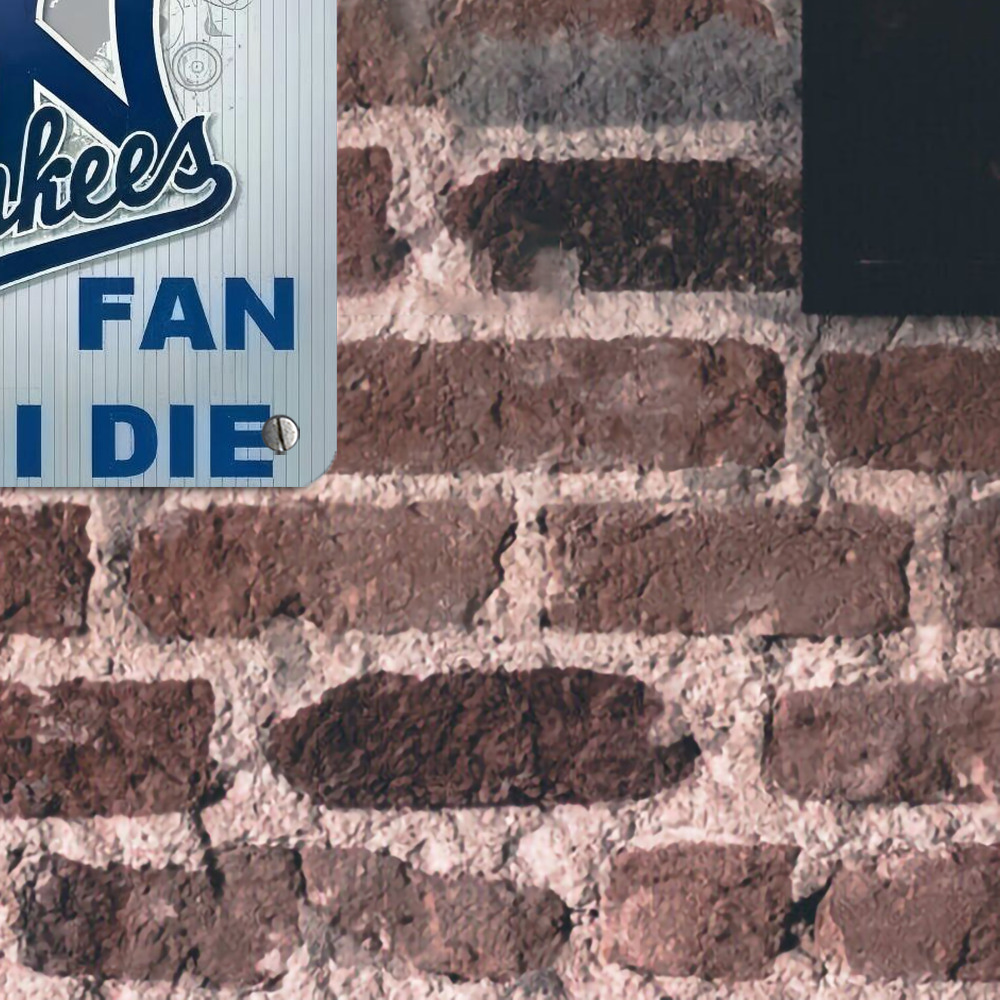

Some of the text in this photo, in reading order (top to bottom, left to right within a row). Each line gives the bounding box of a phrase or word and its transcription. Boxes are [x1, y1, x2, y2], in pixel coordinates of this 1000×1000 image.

[78, 276, 296, 351] FAN
[16, 404, 42, 479] I
[91, 404, 275, 479] DIE
